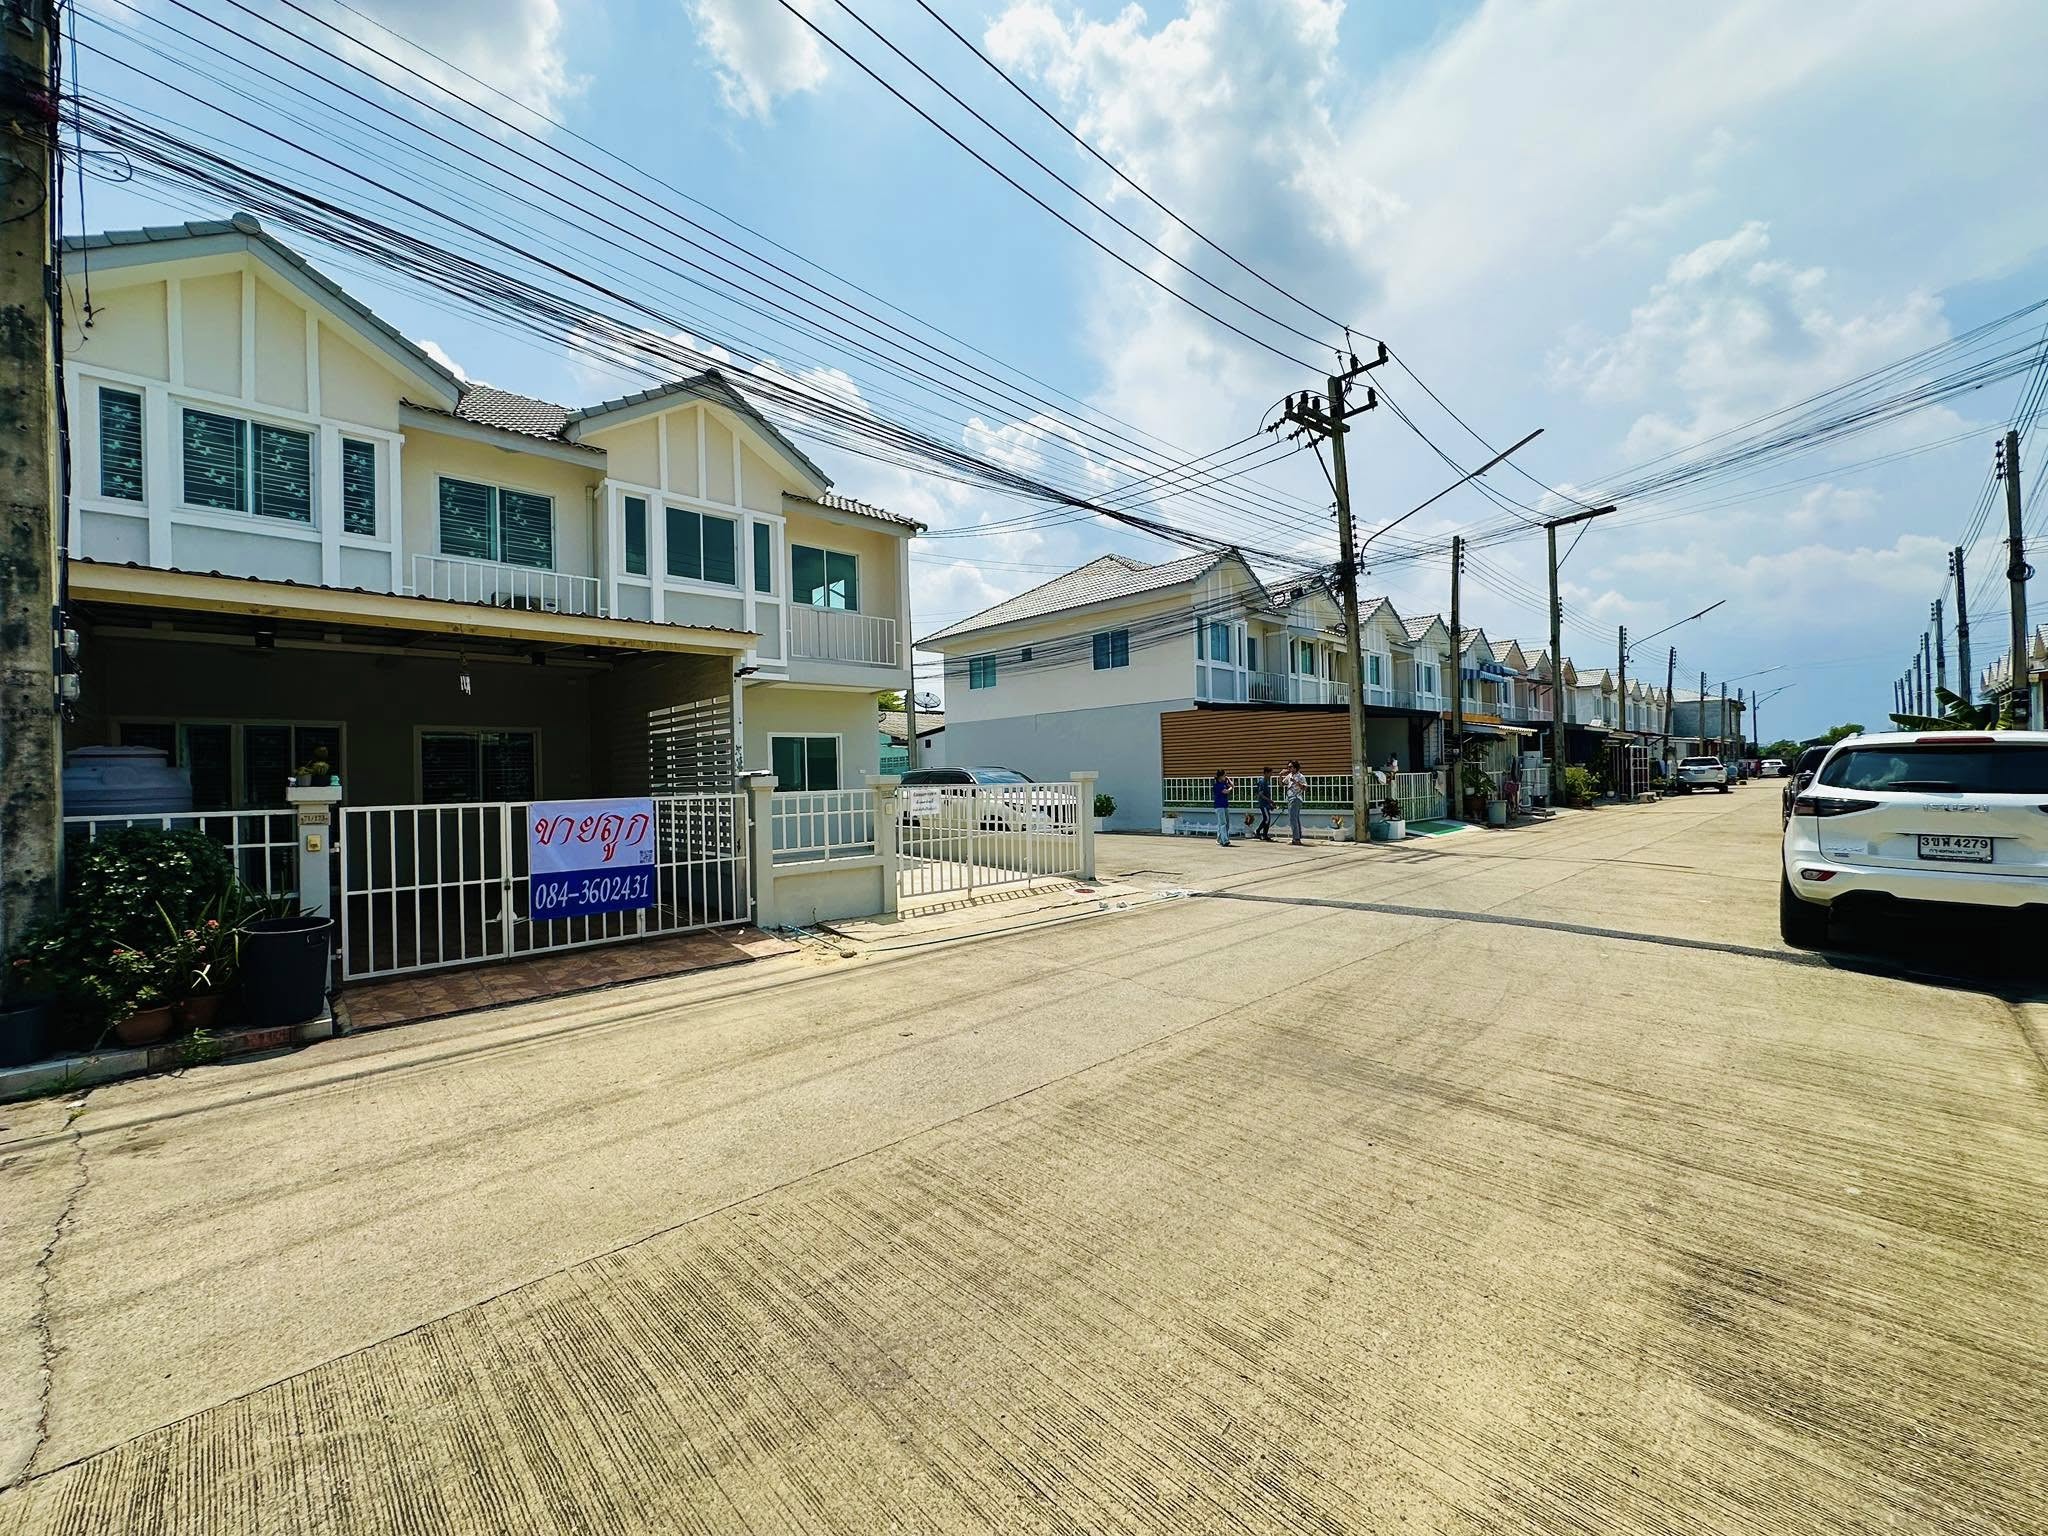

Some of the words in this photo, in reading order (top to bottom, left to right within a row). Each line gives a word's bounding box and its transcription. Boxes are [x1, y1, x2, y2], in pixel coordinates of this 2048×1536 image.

[535, 811, 650, 862] ขายถูก
[1954, 838, 1989, 849] 4279
[535, 875, 649, 910] 084-3602431
